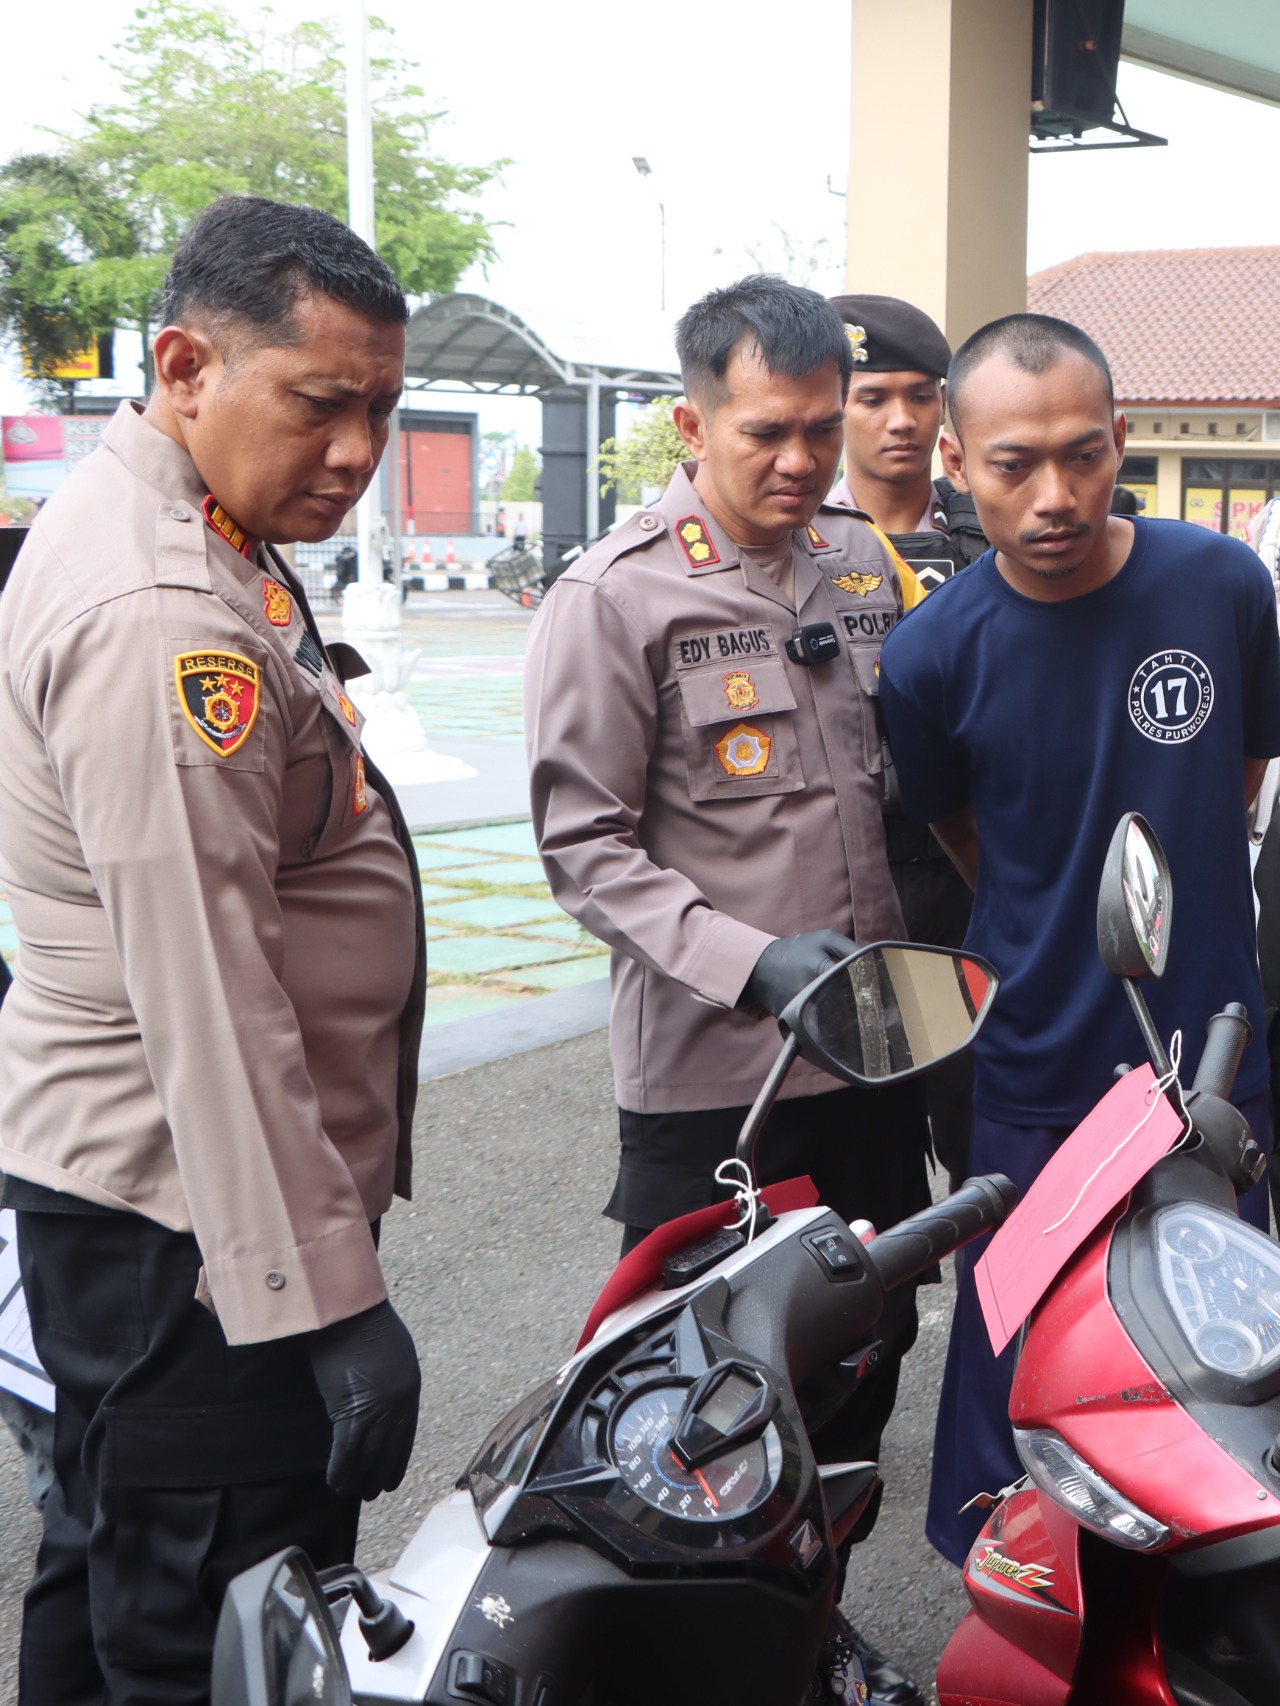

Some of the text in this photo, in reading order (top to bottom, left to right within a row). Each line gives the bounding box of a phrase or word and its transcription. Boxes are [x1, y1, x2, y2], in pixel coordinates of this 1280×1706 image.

[680, 628, 770, 664] EDY BAGUS
[184, 656, 253, 677] RESERSE
[1139, 654, 1196, 678] TAHTI
[1151, 677, 1187, 719] 17
[1132, 686, 1210, 739] POLRES PURWOREJO
[640, 1417, 654, 1434] 120
[655, 1414, 669, 1431] 140
[627, 1434, 643, 1451] 100
[628, 1455, 642, 1471] 80
[638, 1472, 652, 1489] 60
[657, 1486, 670, 1503] 40
[679, 1494, 692, 1510] 20
[703, 1496, 713, 1508] 0
